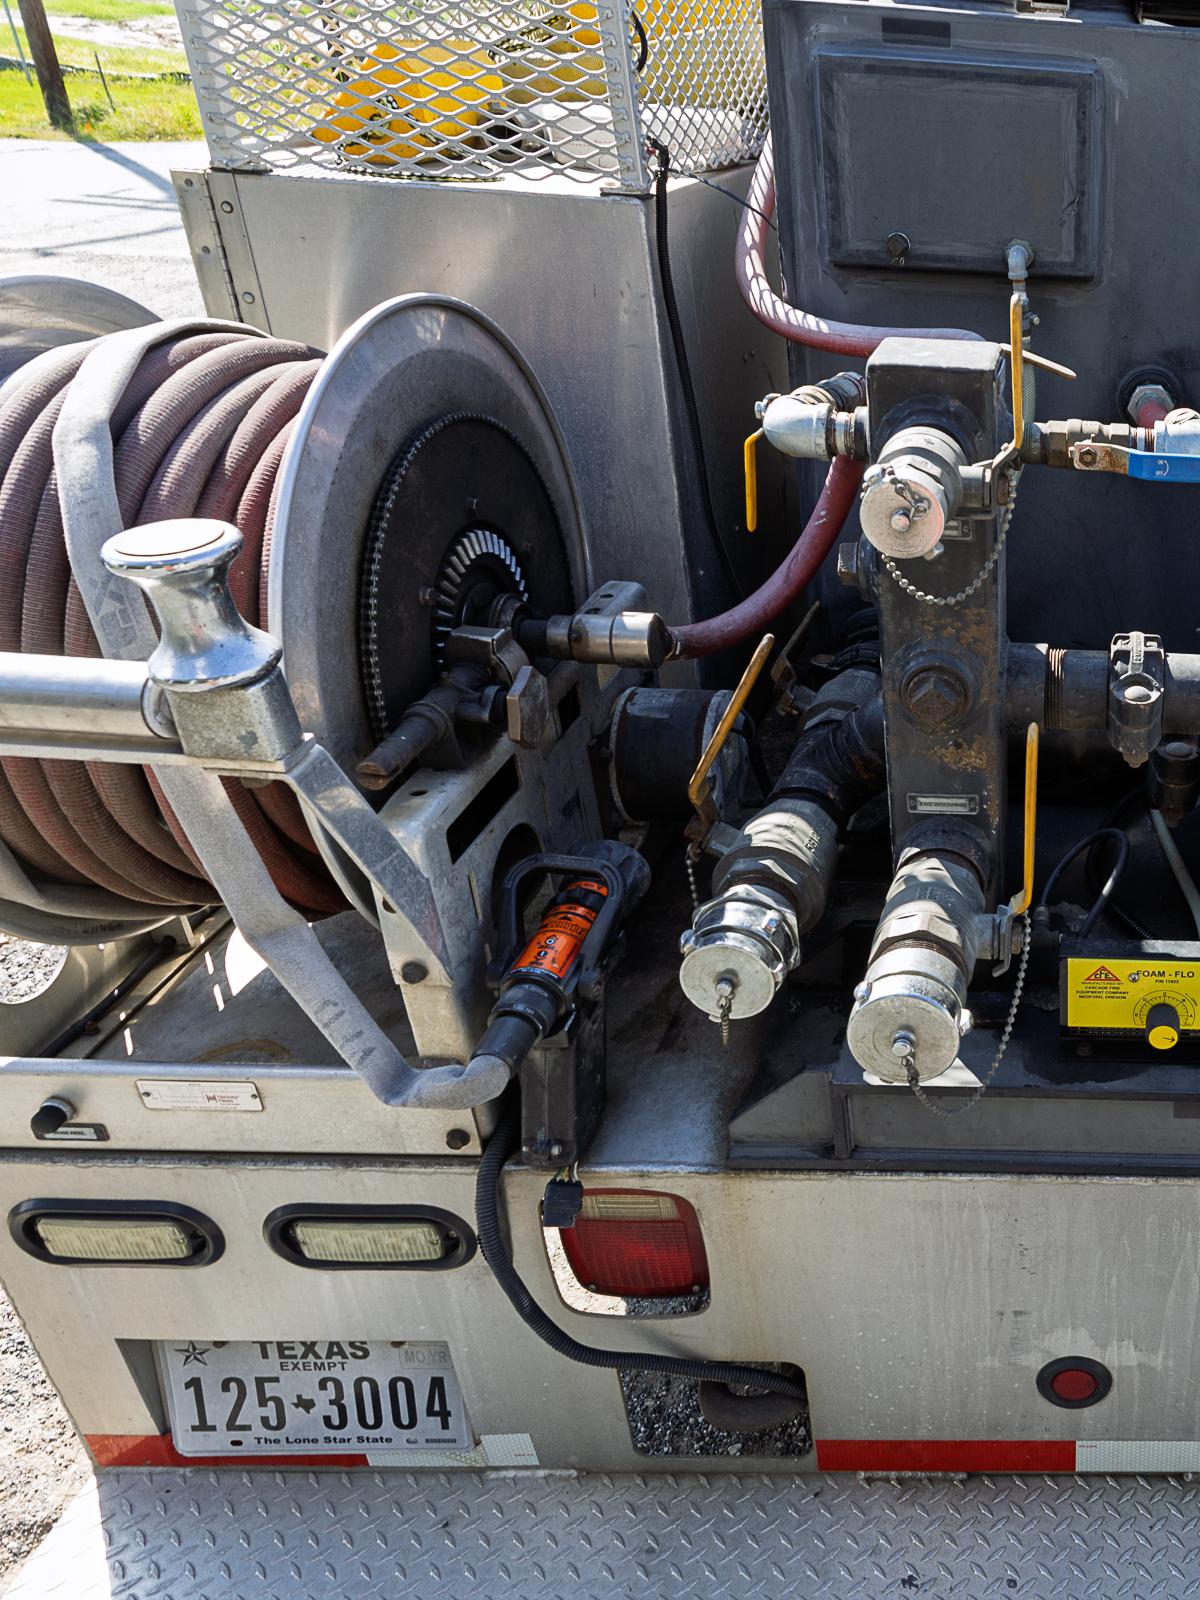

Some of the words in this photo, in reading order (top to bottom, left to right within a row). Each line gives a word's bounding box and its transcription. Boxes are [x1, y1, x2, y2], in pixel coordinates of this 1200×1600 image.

[252, 1341, 370, 1360] TEXAS
[404, 1351, 425, 1363] MO
[430, 1351, 448, 1363] YR
[280, 1362, 347, 1371] EXEMPT
[184, 1376, 287, 1432] 125
[318, 1376, 452, 1431] 3004
[254, 1436, 281, 1445] The
[324, 1436, 352, 1444] Star
